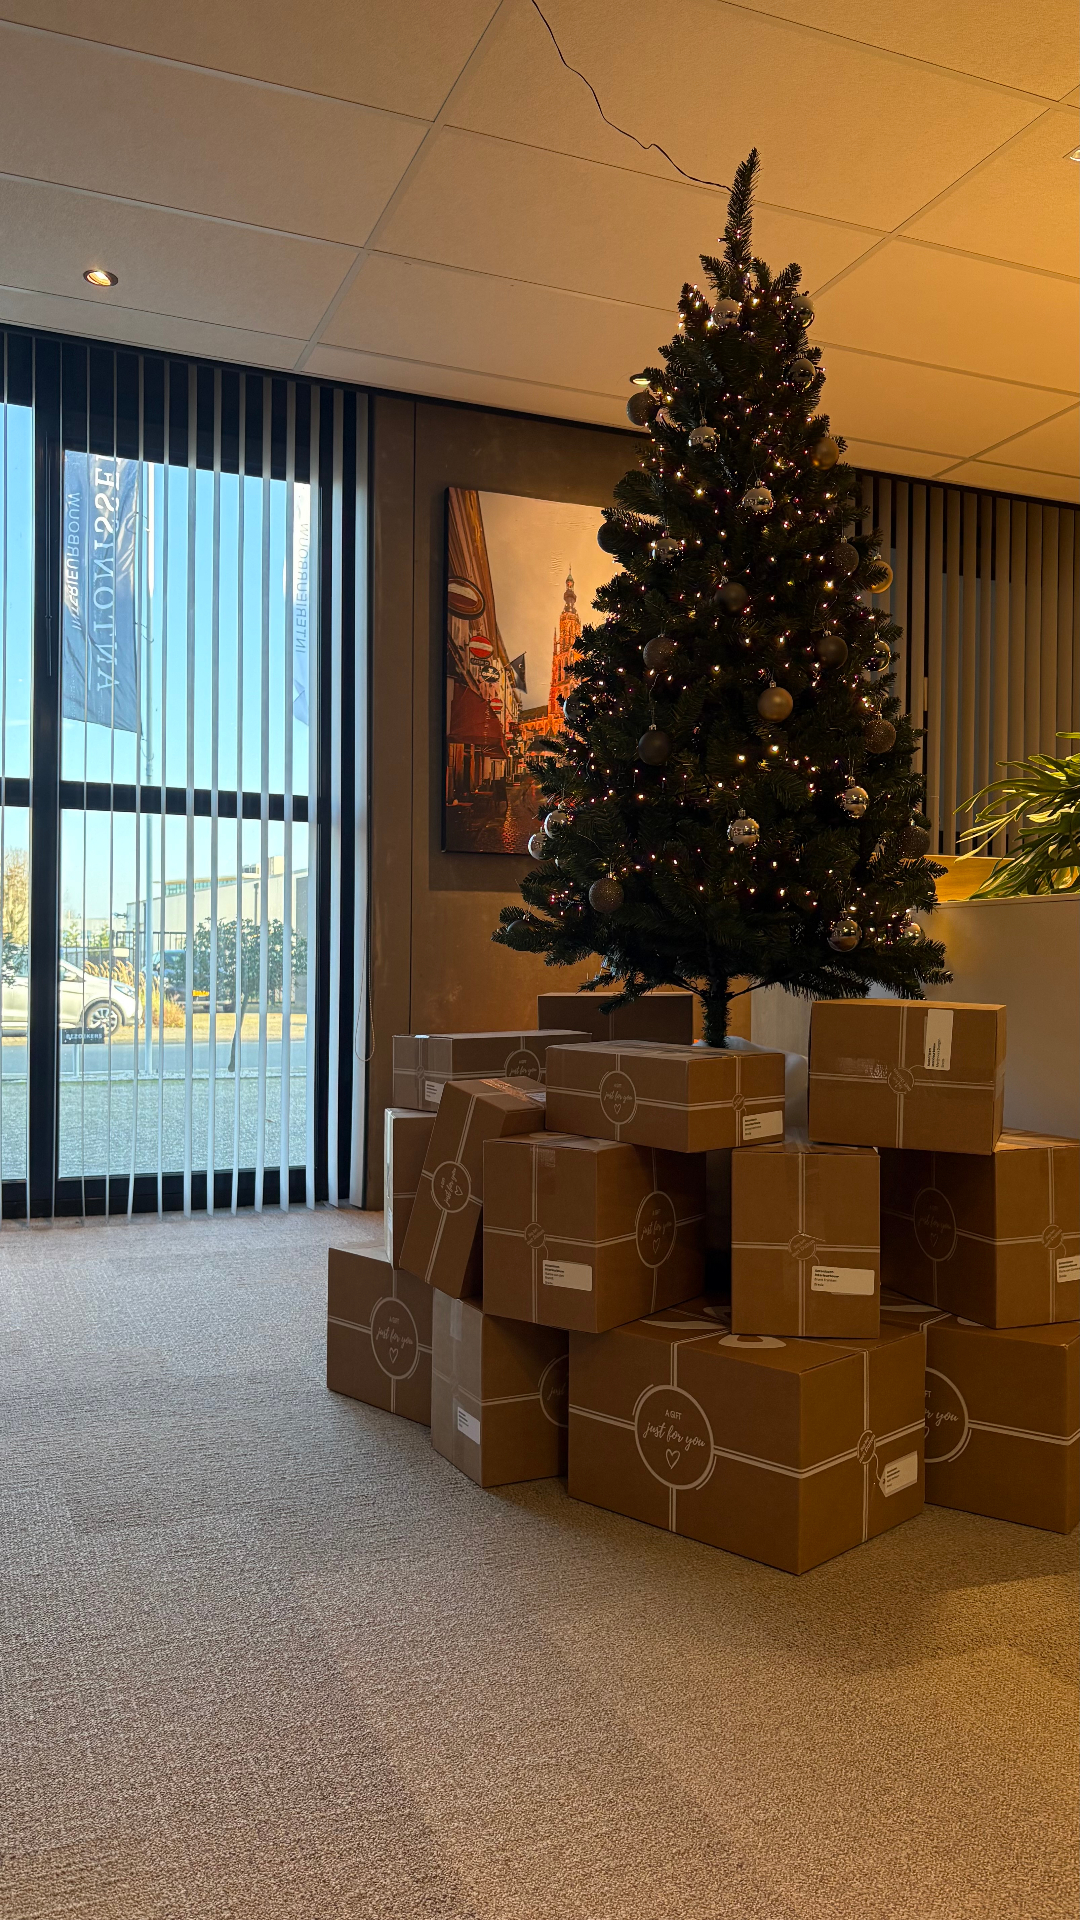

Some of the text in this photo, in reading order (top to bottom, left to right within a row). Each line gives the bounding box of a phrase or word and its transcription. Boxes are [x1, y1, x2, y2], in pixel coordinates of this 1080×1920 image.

[376, 1327, 414, 1349] just for you
[935, 1411, 959, 1427] you
[643, 1421, 706, 1452] just for you
